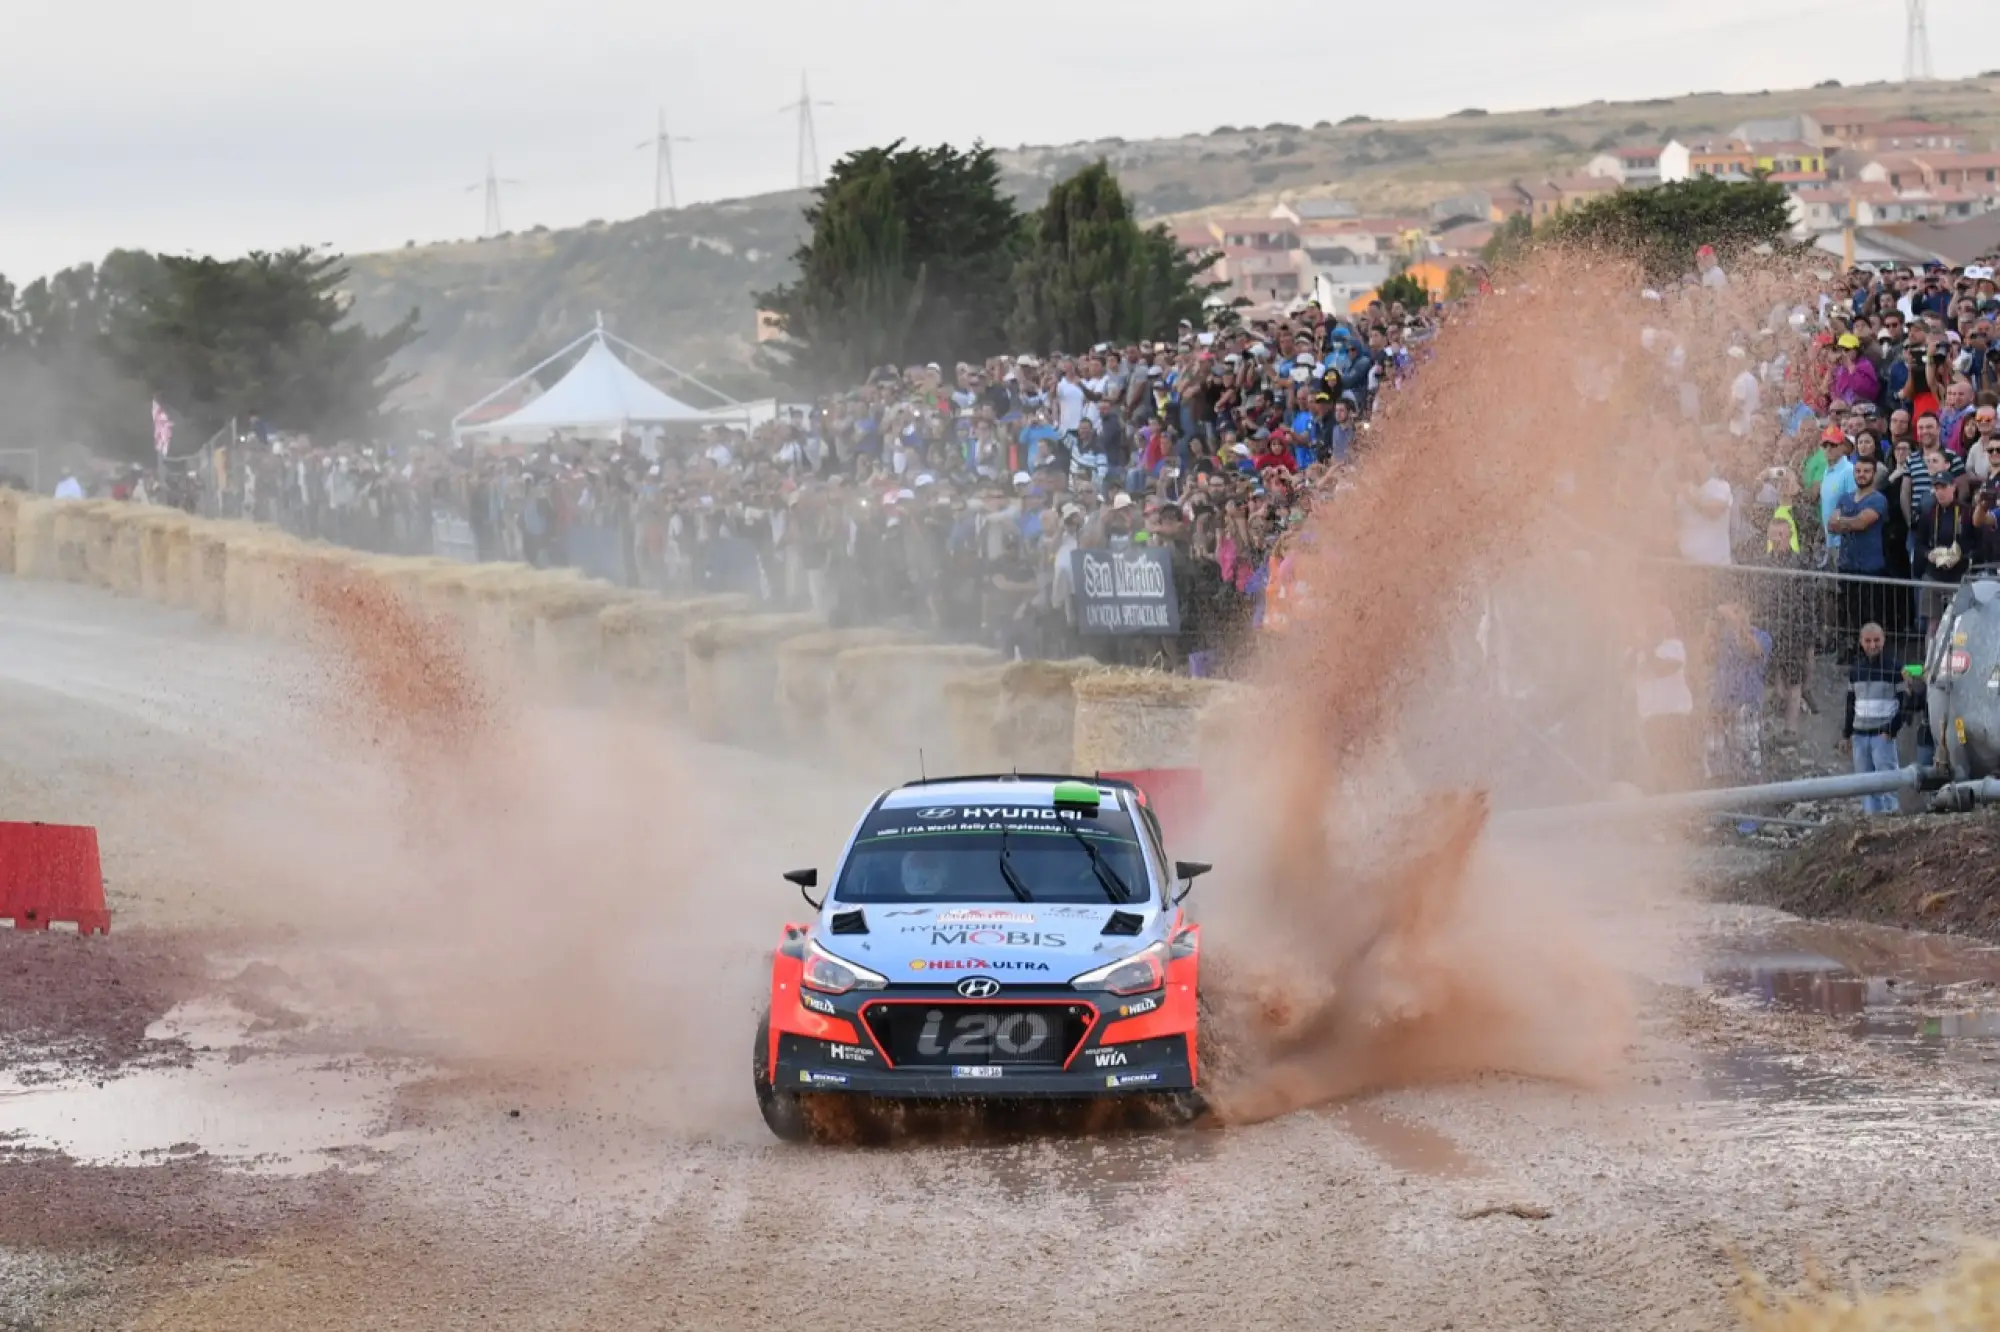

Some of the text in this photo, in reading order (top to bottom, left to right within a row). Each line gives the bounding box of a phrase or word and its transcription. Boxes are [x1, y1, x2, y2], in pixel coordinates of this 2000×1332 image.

[1083, 553, 1165, 598] San Martino
[963, 808, 1082, 821] HYUNDAI
[907, 824, 924, 833] FIA
[927, 823, 957, 832] World
[960, 822, 986, 832] Rally
[989, 822, 1062, 833] Chmpionship
[901, 924, 1003, 933] HYUNDAI
[931, 931, 1067, 946] MOBIS
[929, 957, 1050, 971] HELIX ULTRA
[810, 999, 836, 1015] HELIX
[1128, 998, 1157, 1015] HELIX
[917, 1009, 1048, 1054] i20
[1095, 1051, 1128, 1067] WIA
